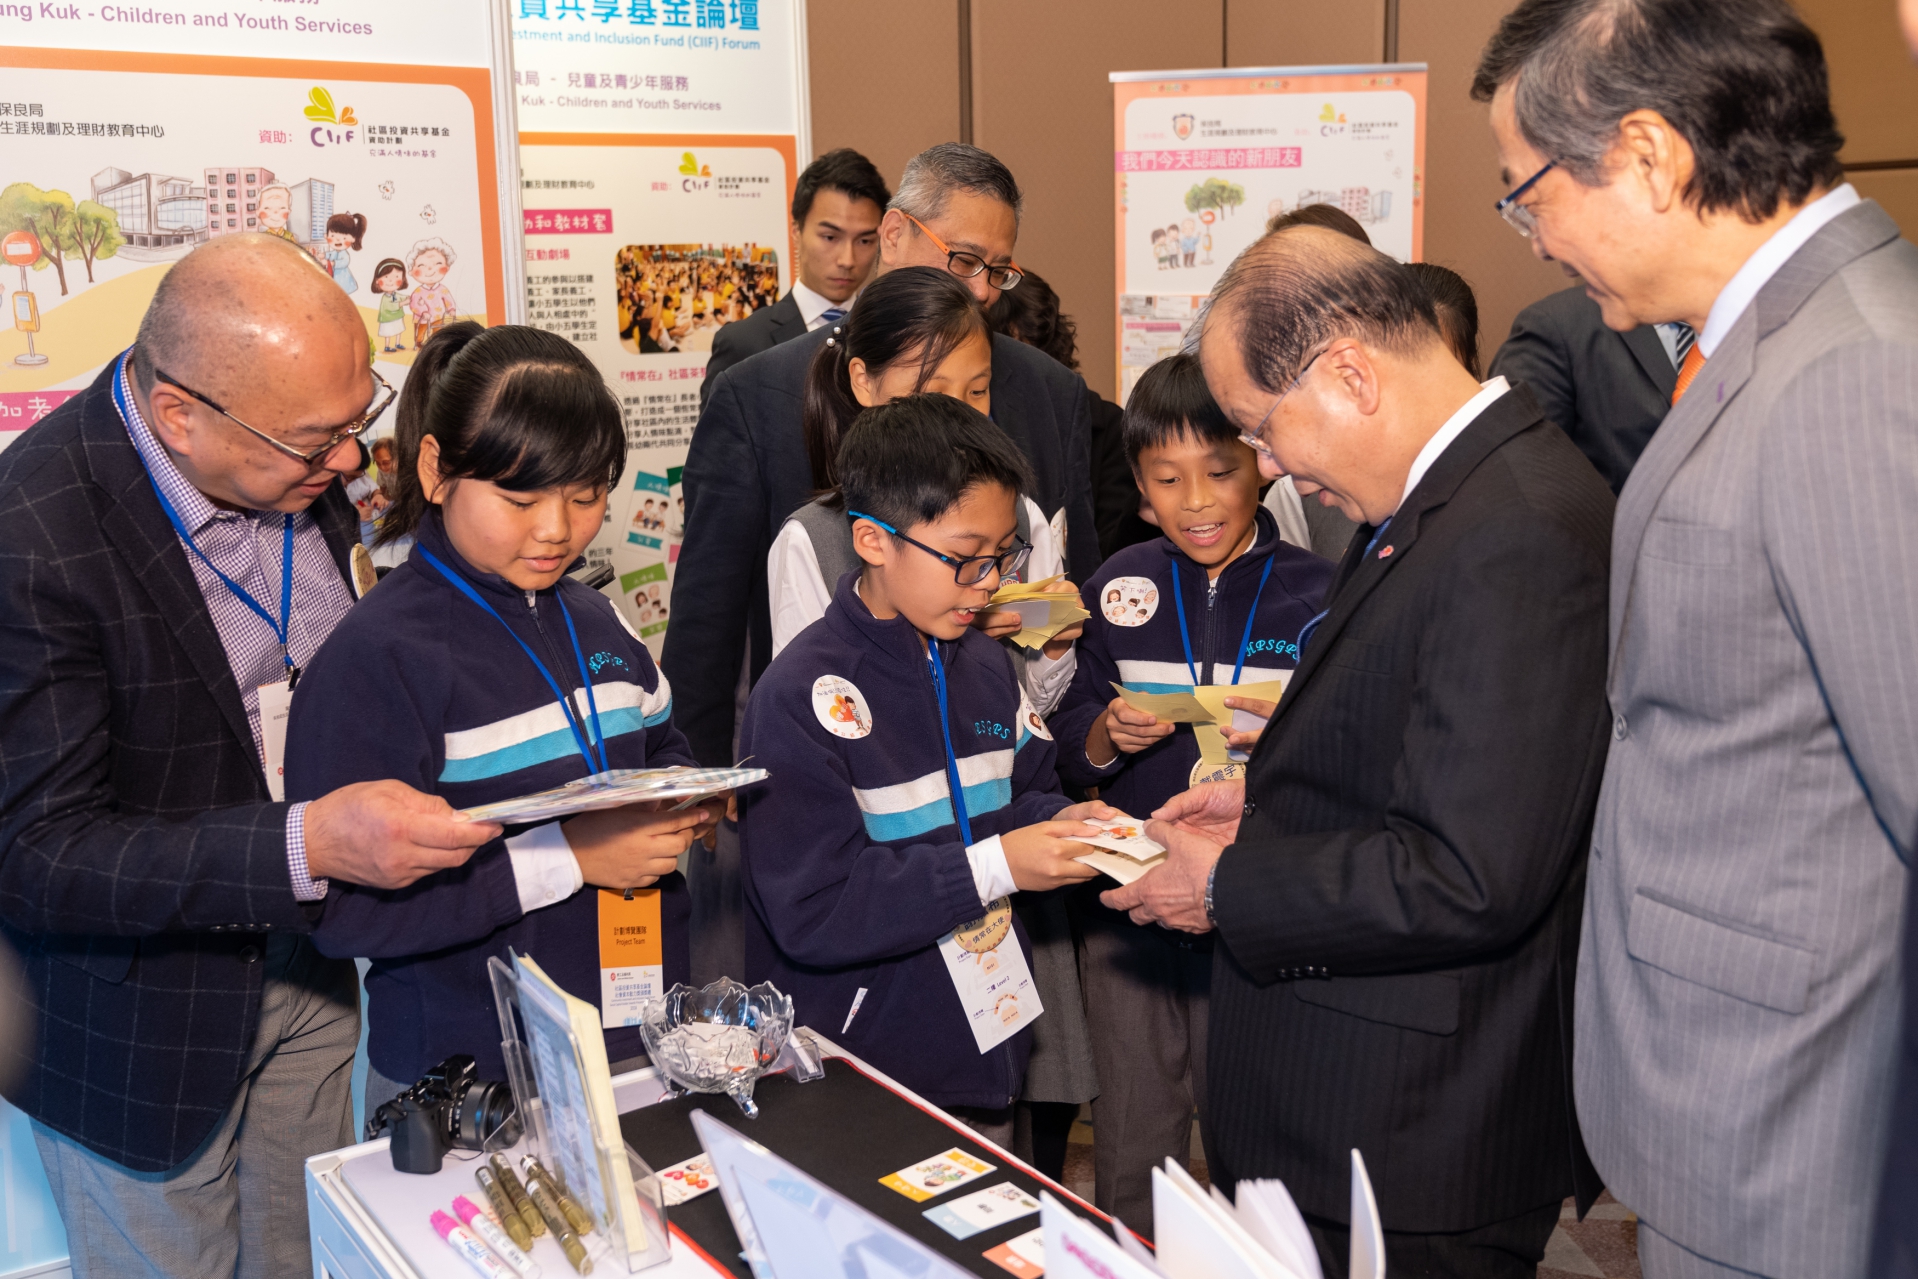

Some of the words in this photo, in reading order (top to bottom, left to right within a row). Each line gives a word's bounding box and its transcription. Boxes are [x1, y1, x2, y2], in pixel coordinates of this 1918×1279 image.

[39, 2, 81, 20] Kuk
[101, 6, 186, 25] Children
[193, 12, 228, 27] and
[234, 13, 288, 30] Youth
[295, 16, 372, 35] Services
[510, 0, 760, 30] 資共享基金論壇
[567, 30, 590, 43] and
[594, 32, 651, 46] Inclusion
[654, 34, 685, 47] Fund
[687, 35, 719, 50] (CIIF)
[722, 37, 760, 50] Forum
[568, 72, 689, 91] 兒童及青少年服務
[0, 102, 43, 117] 保良局
[522, 95, 546, 107] Kuk
[557, 96, 608, 109] Children
[611, 98, 633, 109] and
[637, 98, 670, 110] Youth
[673, 100, 722, 111] Services
[0, 121, 165, 138] 生涯規劃及理財教育中心
[368, 125, 450, 137] 社區投資共享基金
[1122, 147, 1299, 170] 我們今天認識的新朋友
[972, 916, 1005, 944] 情常在大使
[616, 938, 633, 947] Project
